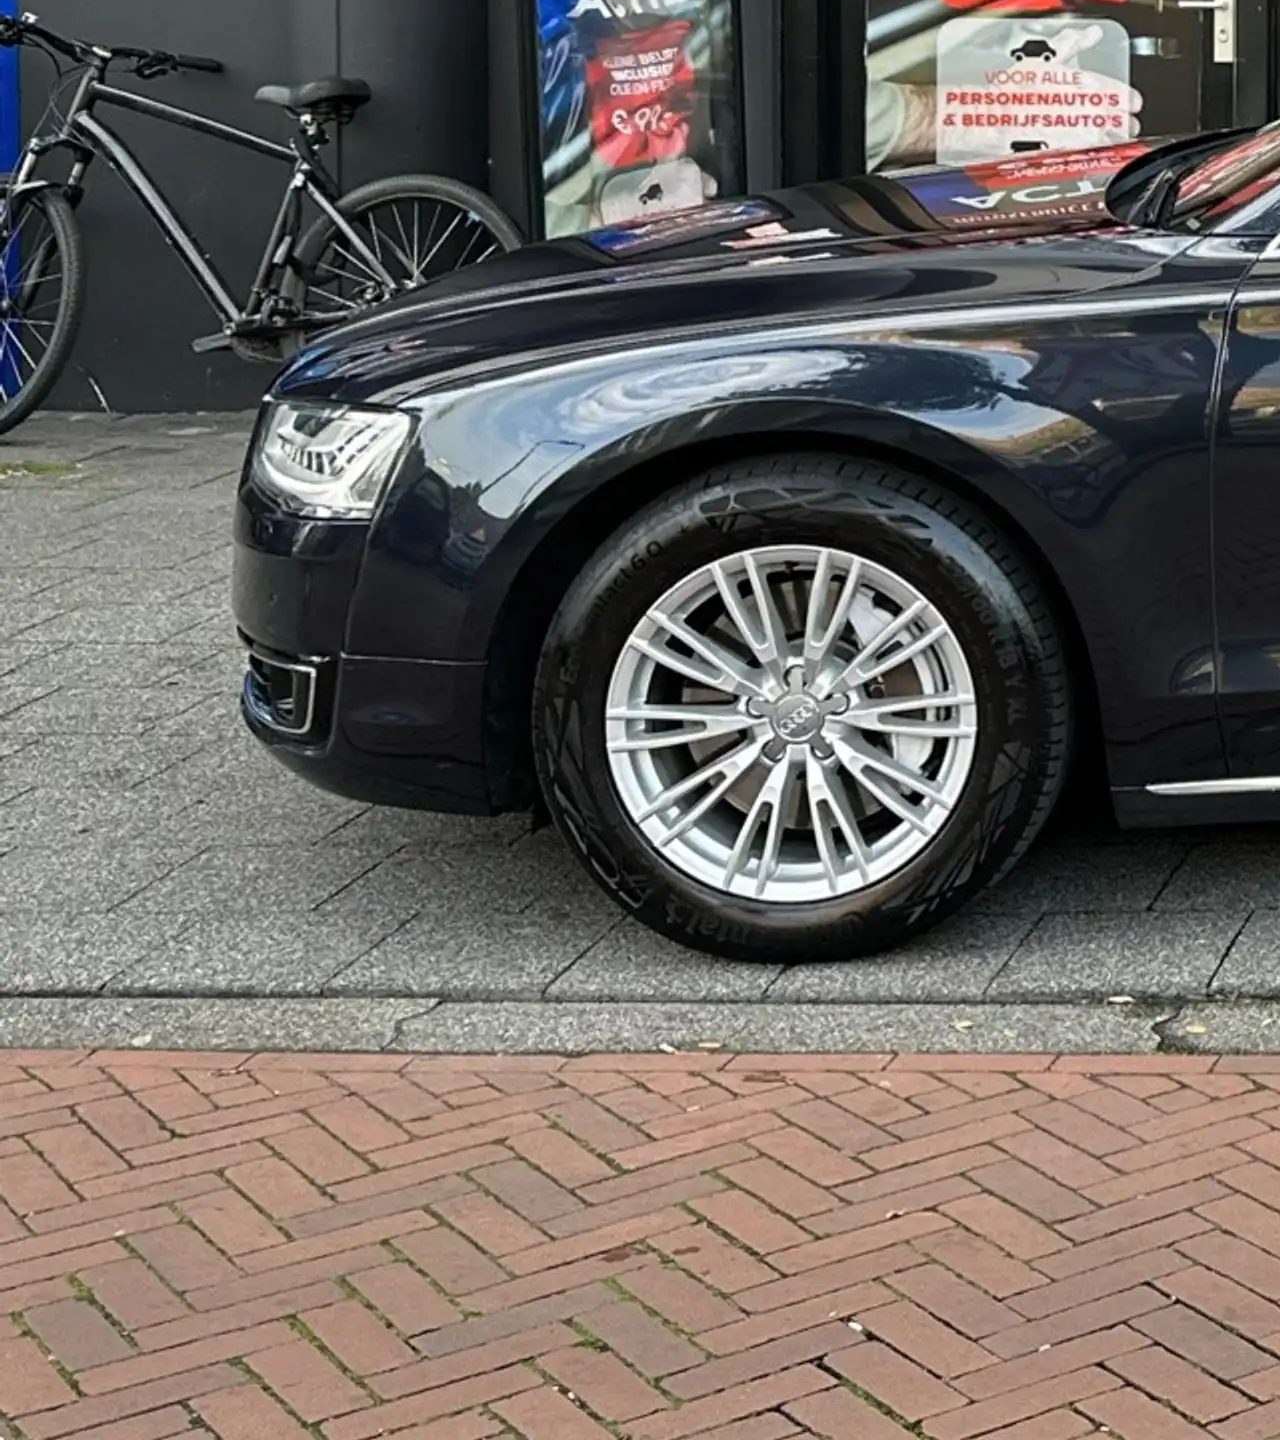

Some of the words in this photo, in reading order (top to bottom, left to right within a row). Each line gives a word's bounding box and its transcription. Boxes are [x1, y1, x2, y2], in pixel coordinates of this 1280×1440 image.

[985, 69, 1037, 85] VOOR
[1042, 70, 1082, 85] ALLE
[945, 91, 1120, 107] PERSONENAUTO'S
[943, 113, 956, 127] &
[962, 113, 1123, 128] BEDRIJFSAUTO'S
